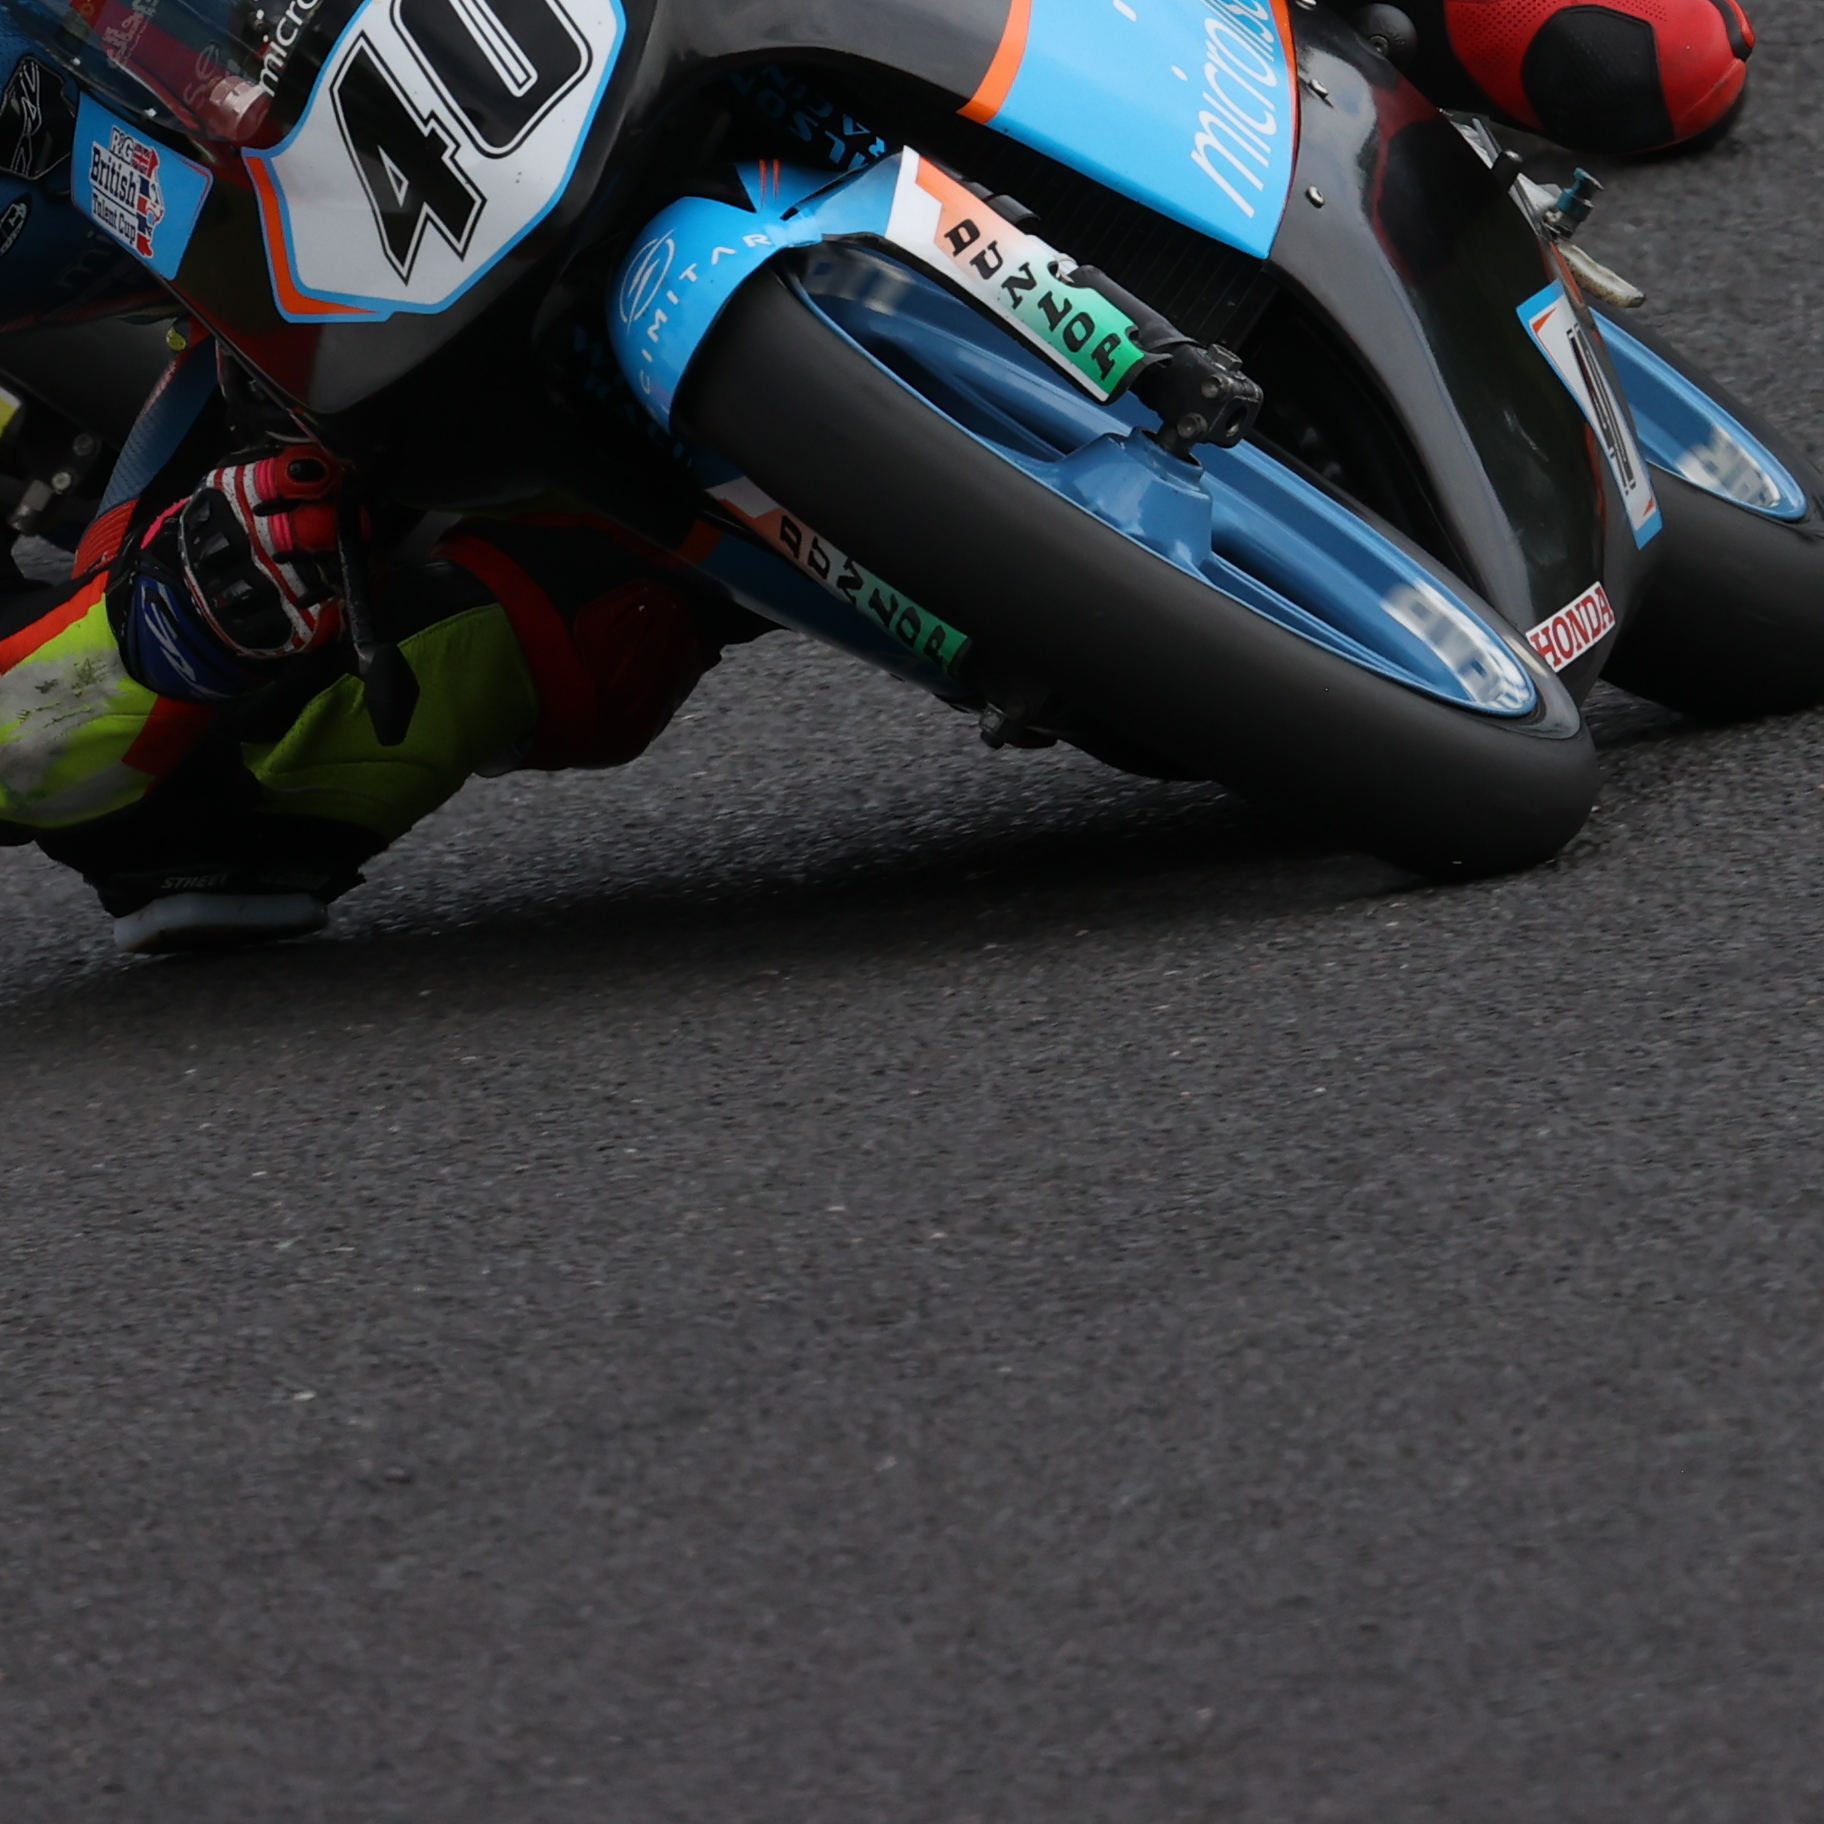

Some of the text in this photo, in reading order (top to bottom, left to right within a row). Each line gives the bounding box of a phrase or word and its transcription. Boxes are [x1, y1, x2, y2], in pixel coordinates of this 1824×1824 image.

[90, 145, 136, 209] British
[118, 214, 136, 245] Cup
[639, 233, 773, 396] CIMITAR
[943, 218, 1122, 382] DUNLOP
[778, 513, 949, 674] DUNLOP
[1529, 585, 1616, 667] HONDA
